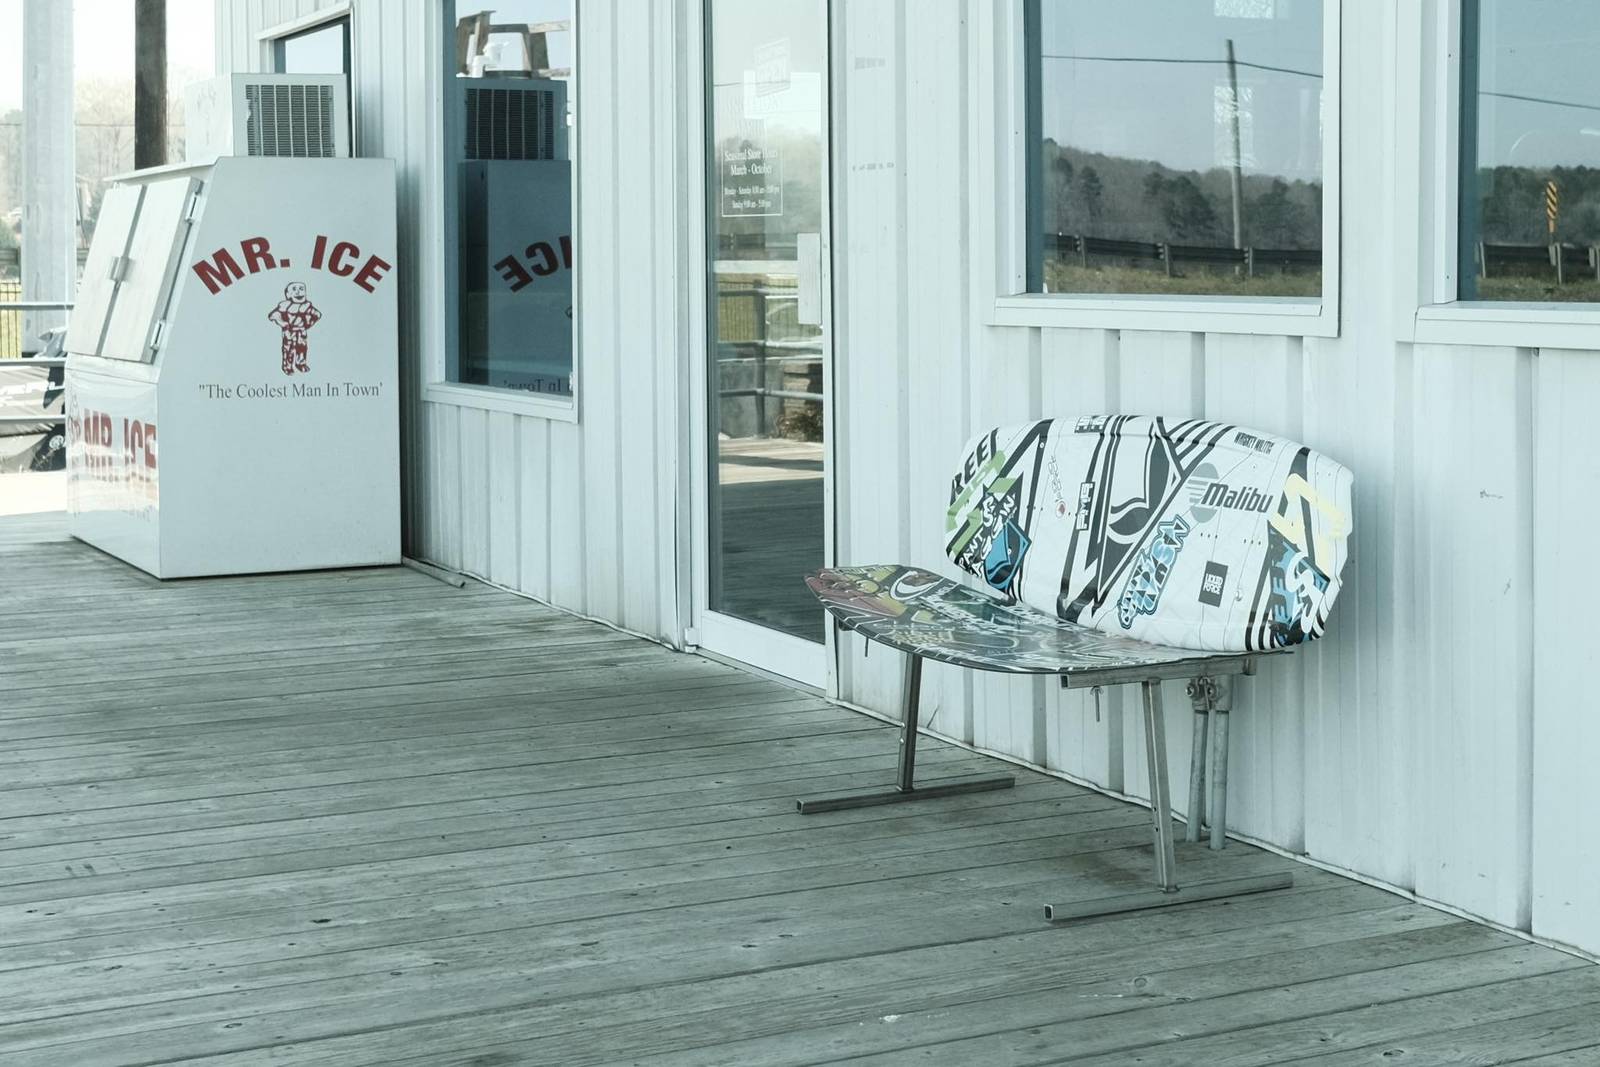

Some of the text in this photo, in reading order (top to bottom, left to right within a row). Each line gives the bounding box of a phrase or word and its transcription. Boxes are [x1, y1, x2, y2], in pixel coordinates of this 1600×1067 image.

[192, 235, 392, 295] MR. ICE
[236, 383, 287, 398] Coolest
[292, 383, 321, 398] Man
[327, 383, 339, 397] In
[1201, 482, 1274, 513] Malibu
